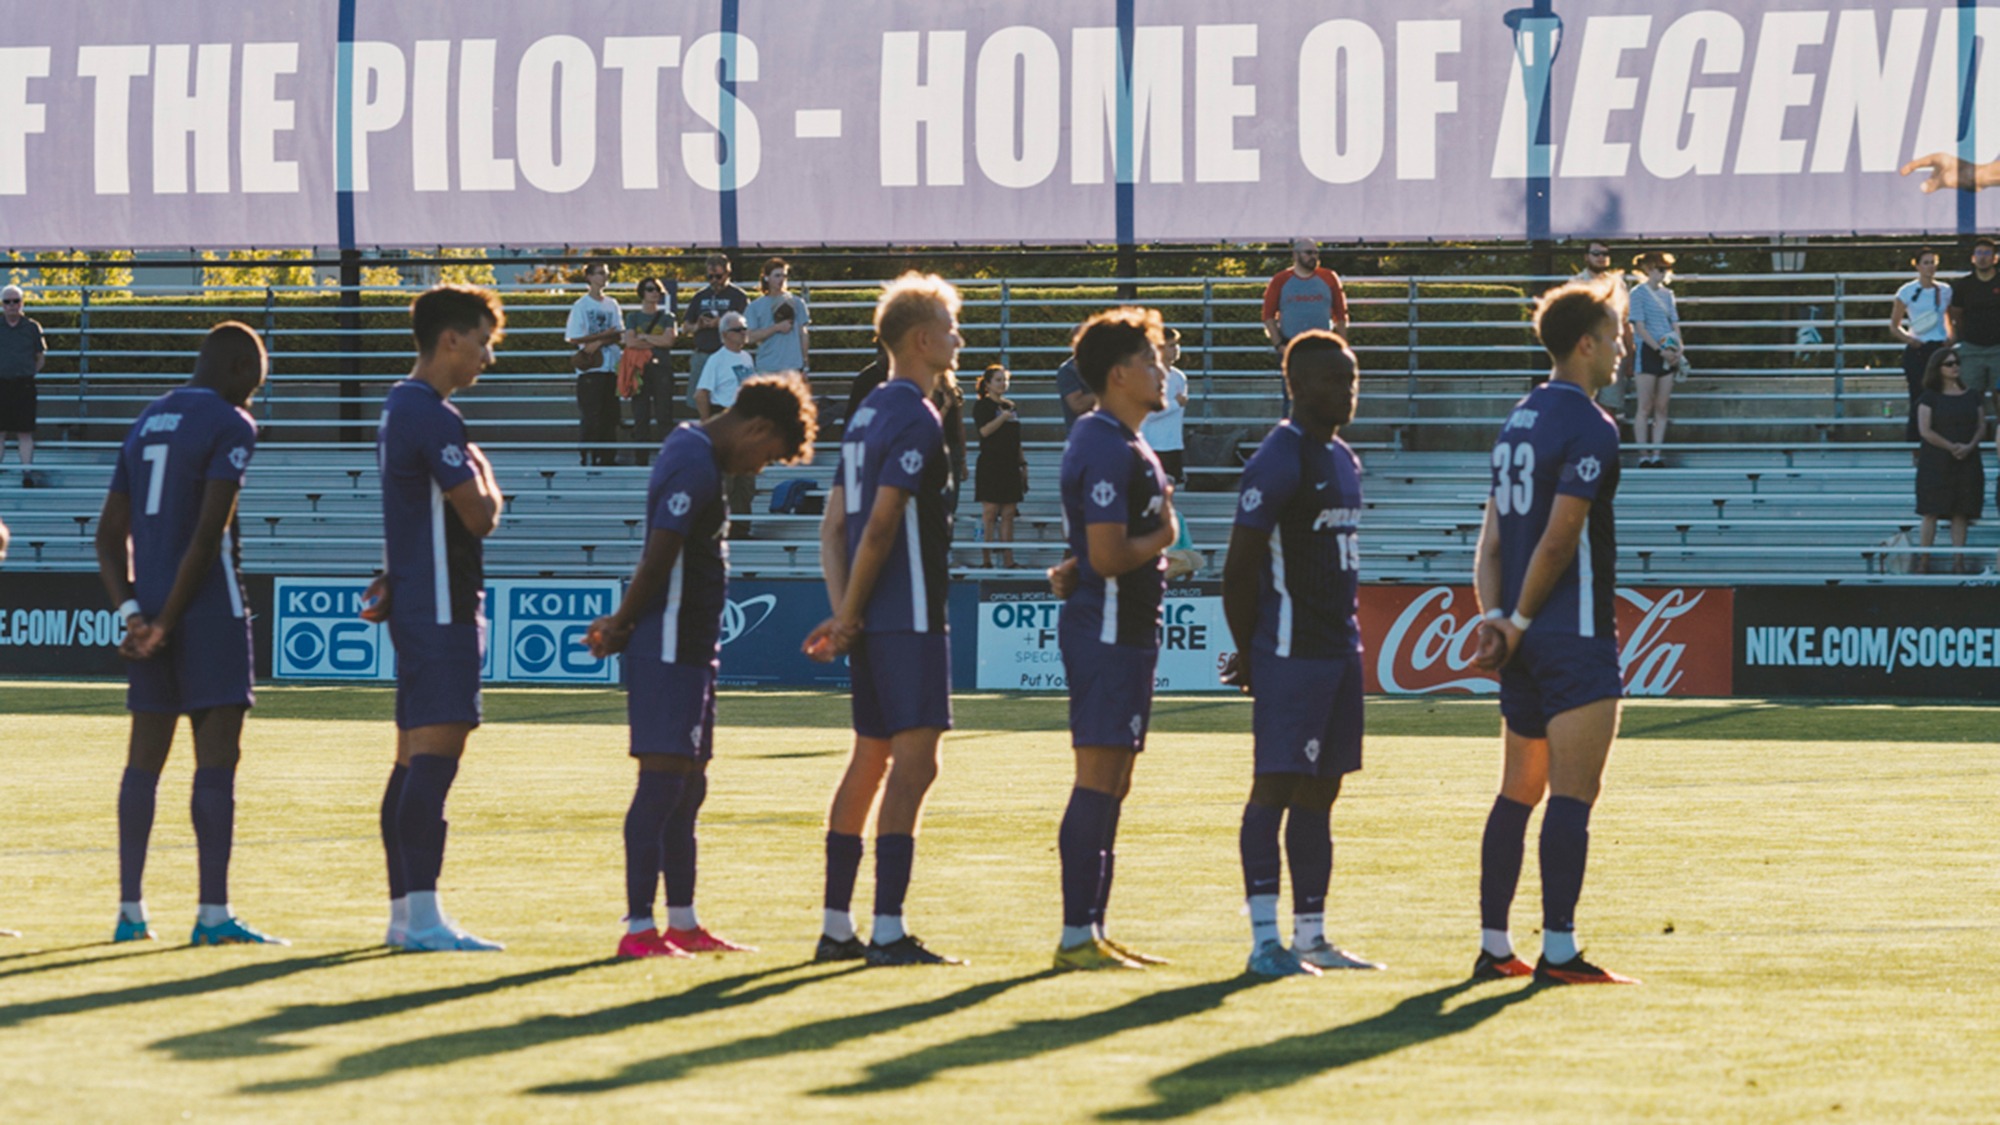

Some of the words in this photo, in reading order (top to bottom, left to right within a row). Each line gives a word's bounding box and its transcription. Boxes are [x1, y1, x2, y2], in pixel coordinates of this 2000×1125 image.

[77, 42, 299, 195] THE
[333, 31, 761, 192] PILOTS
[795, 109, 842, 137] -
[880, 25, 1260, 188] HOME
[1298, 19, 1461, 183] OF
[1493, 442, 1535, 516] 33
[519, 593, 603, 615] KOIN
[992, 603, 1065, 629] ORT
[1746, 627, 2000, 673] NIKE.COM/SOCCE
[1021, 673, 1041, 687] Put
